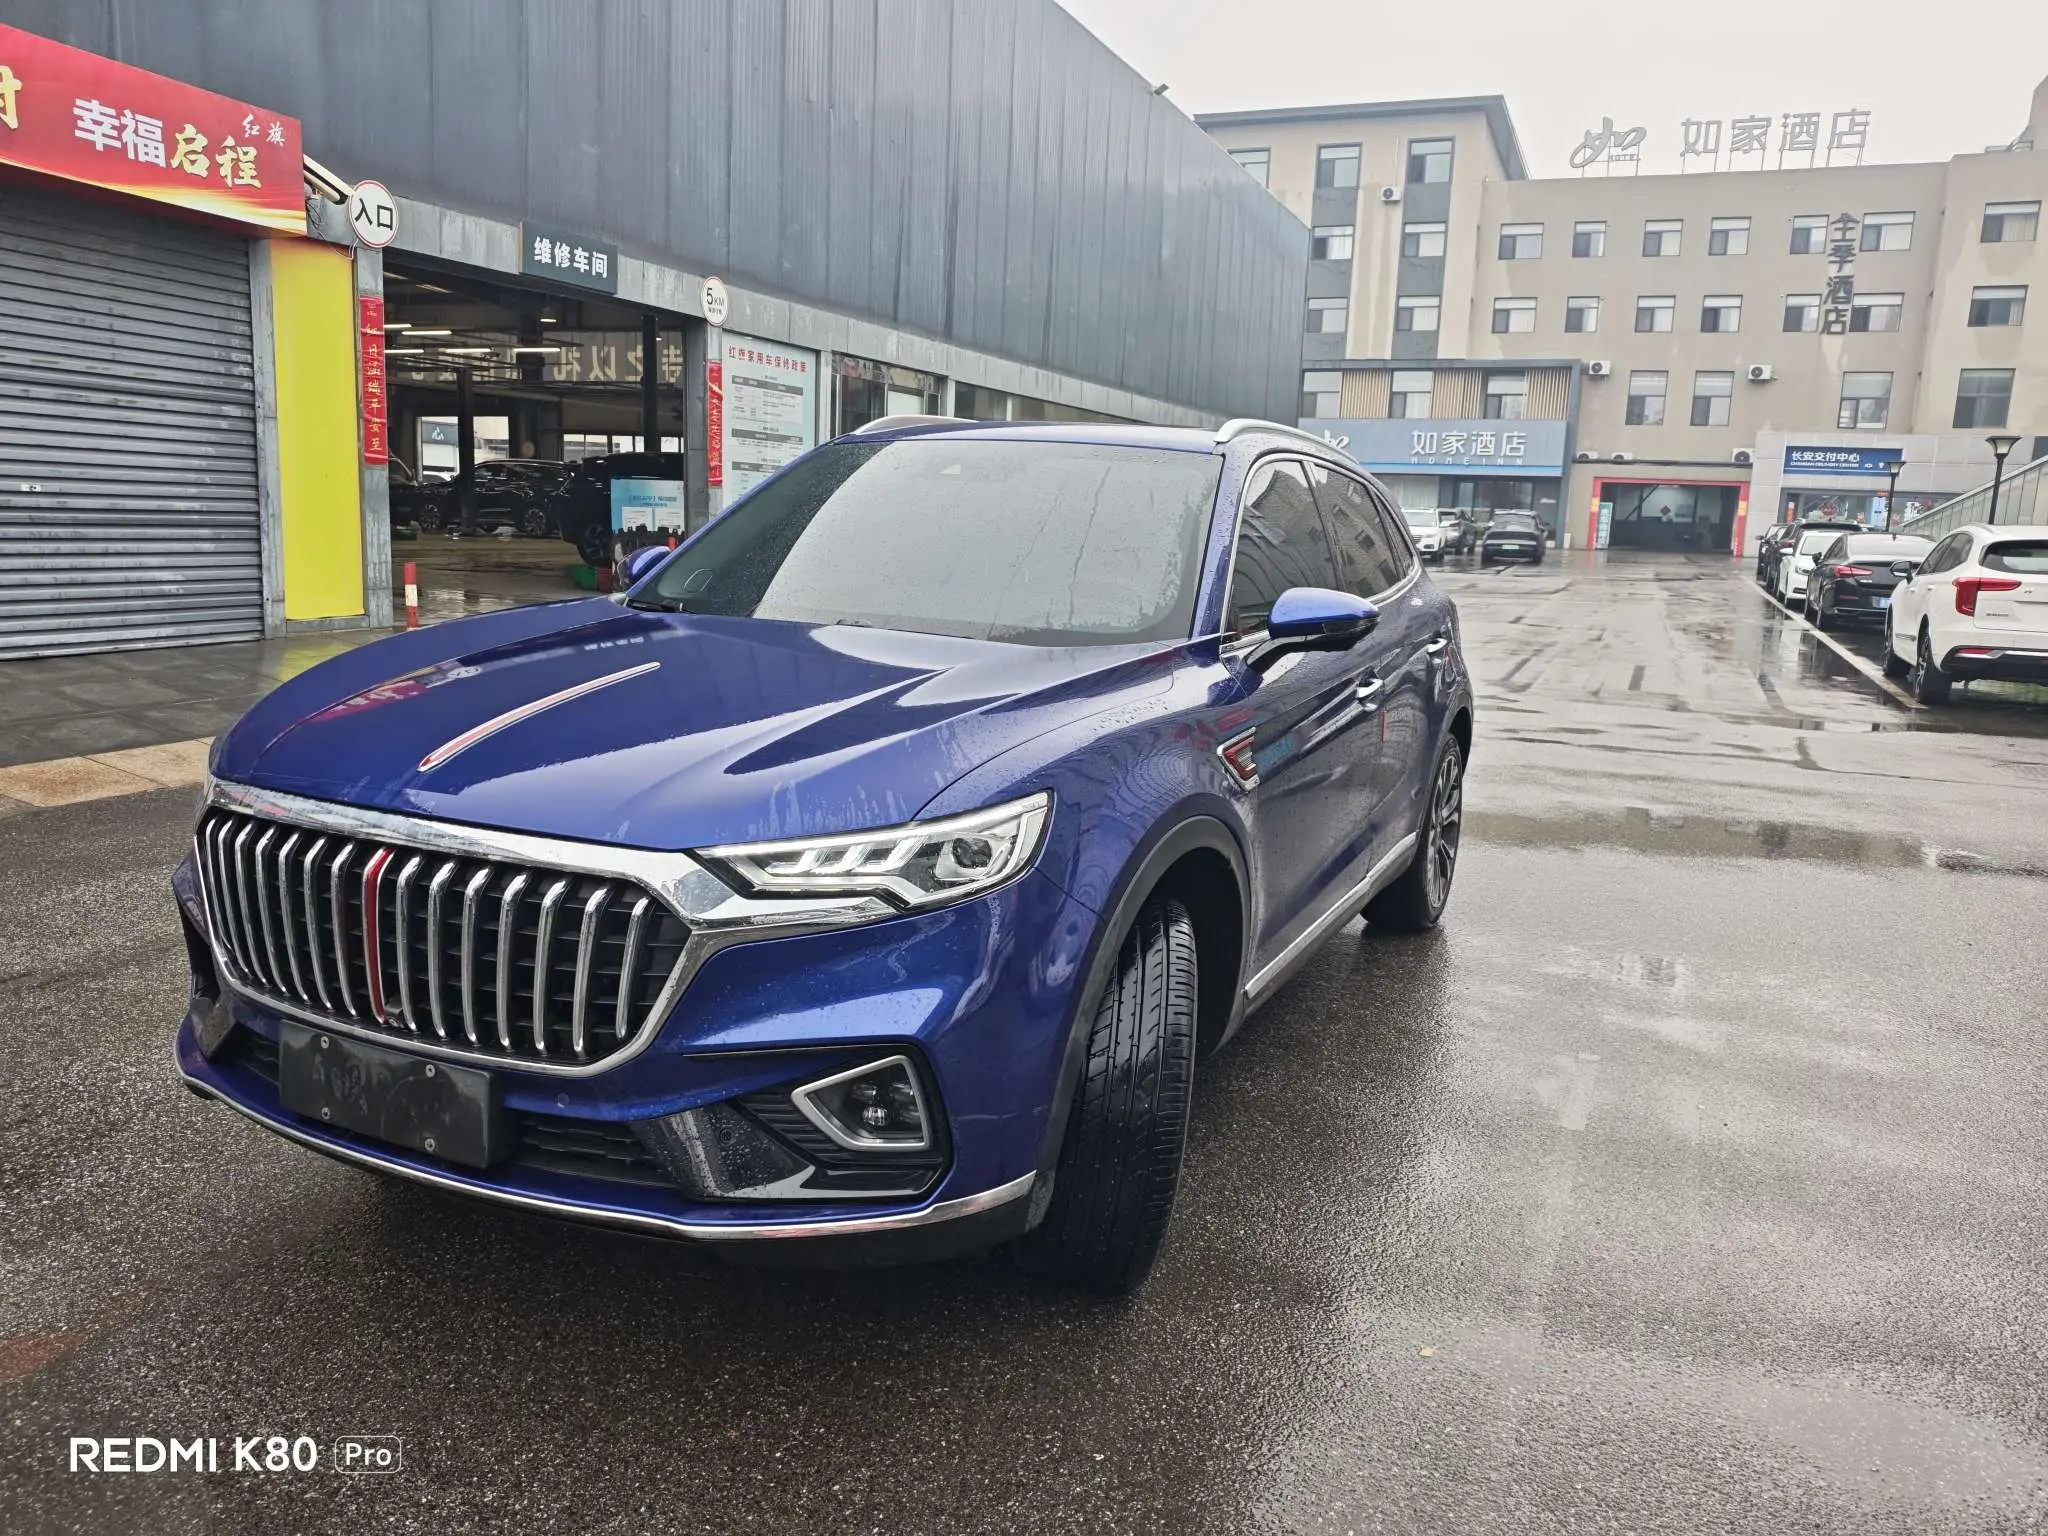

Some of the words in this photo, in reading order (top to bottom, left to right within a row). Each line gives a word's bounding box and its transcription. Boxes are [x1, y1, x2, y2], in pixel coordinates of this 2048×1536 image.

[73, 98, 262, 189] 幸福启程
[242, 113, 286, 147] 红旗
[1680, 108, 1871, 157] 如家酒店
[354, 197, 394, 231] 入口
[533, 235, 608, 279] 维修车间
[1820, 212, 1860, 335] 全季酒店
[1410, 429, 1528, 457] 如家酒店
[1791, 451, 1860, 462] 长安交付中心
